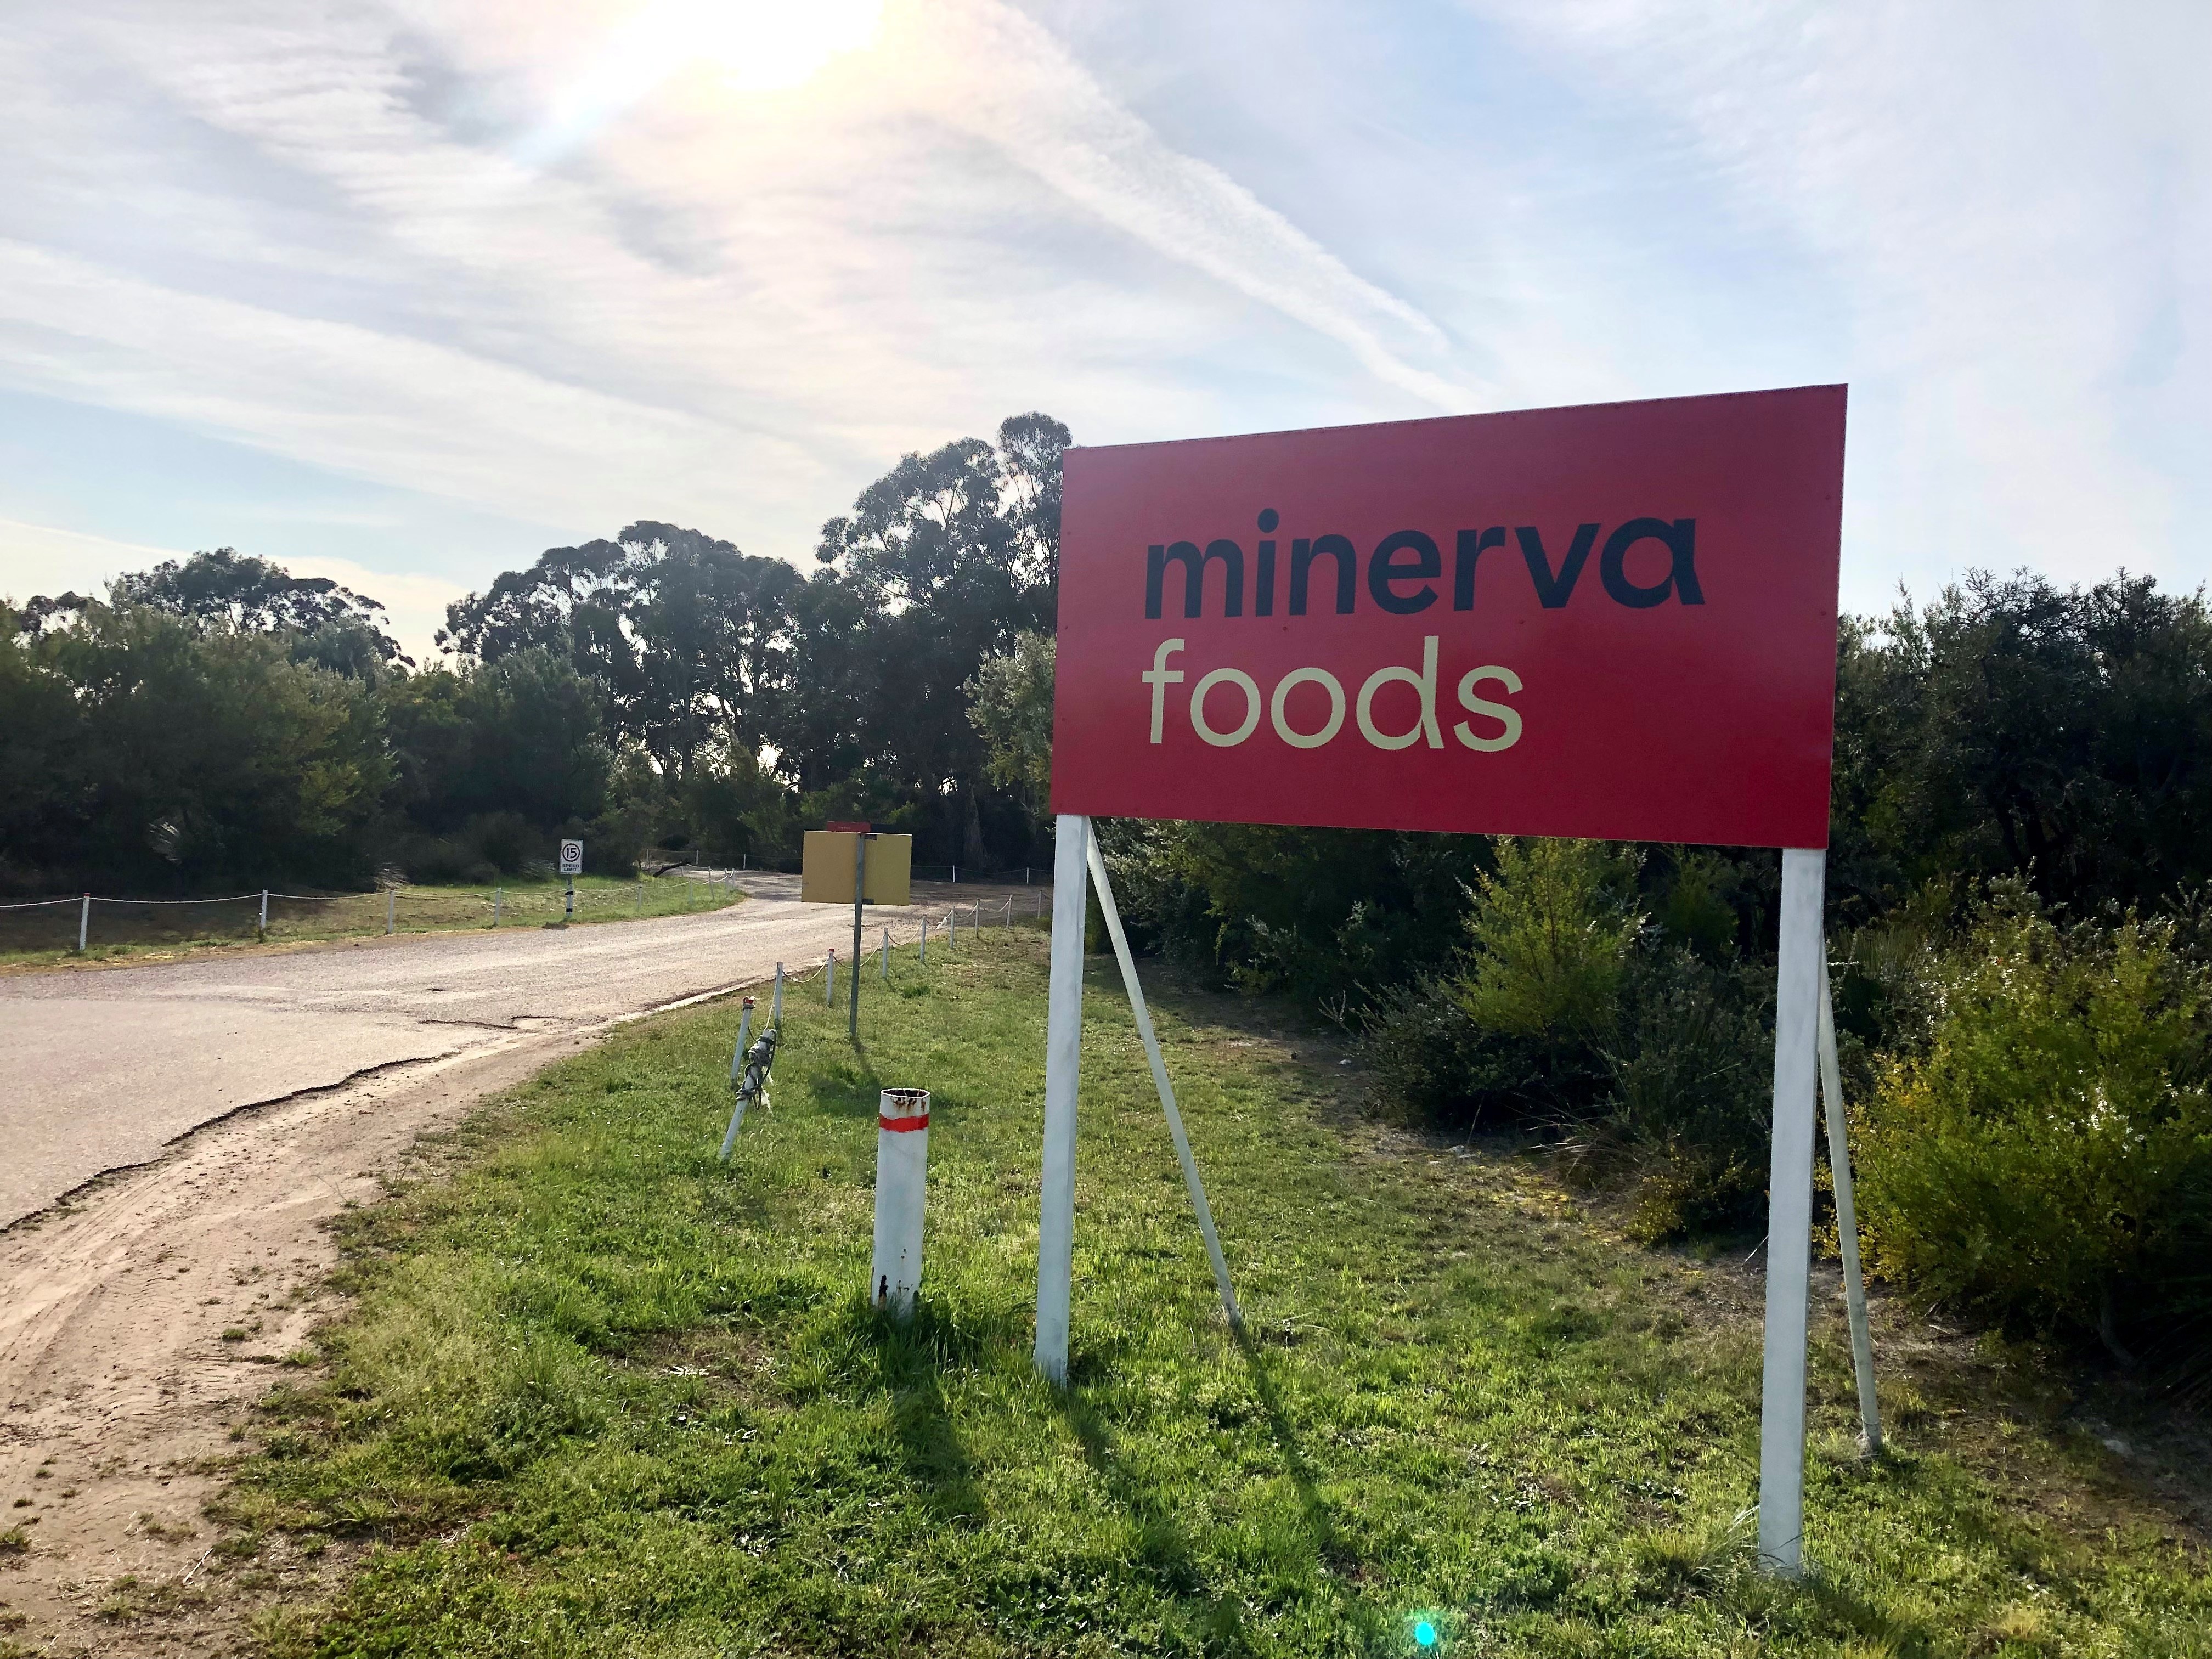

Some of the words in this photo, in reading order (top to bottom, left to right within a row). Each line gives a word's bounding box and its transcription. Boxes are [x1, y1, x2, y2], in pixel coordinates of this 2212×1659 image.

[1145, 507, 1706, 619] minerva
[1141, 635, 1523, 753] foods
[566, 848, 577, 859] 15
